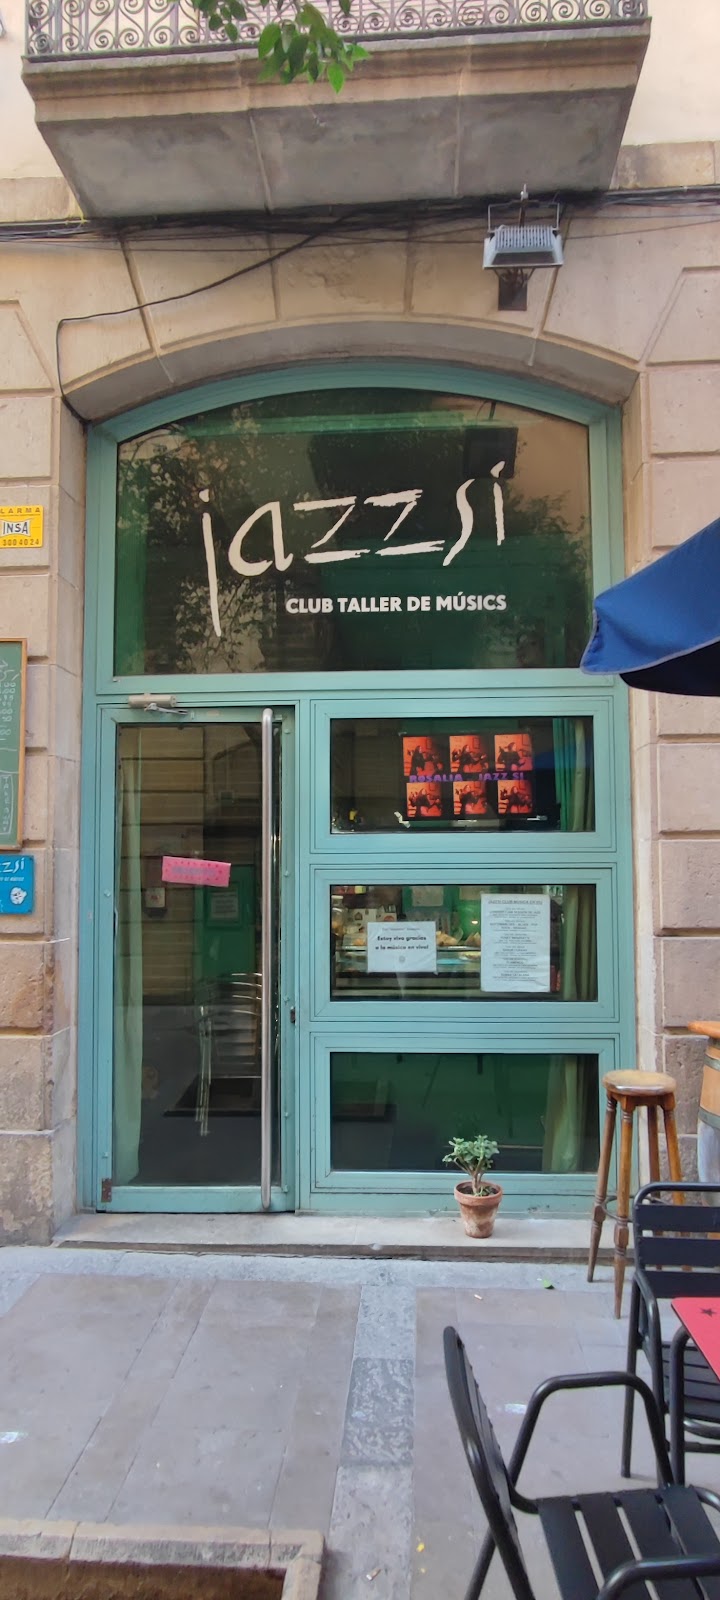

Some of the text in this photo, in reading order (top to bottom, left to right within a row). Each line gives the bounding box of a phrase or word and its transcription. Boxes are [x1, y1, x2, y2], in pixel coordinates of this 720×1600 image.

[198, 460, 506, 637] jazzsi
[285, 591, 507, 614] CLUB TALLER DE MÚSICS
[479, 772, 508, 781] JAZZ
[512, 772, 524, 780] SI
